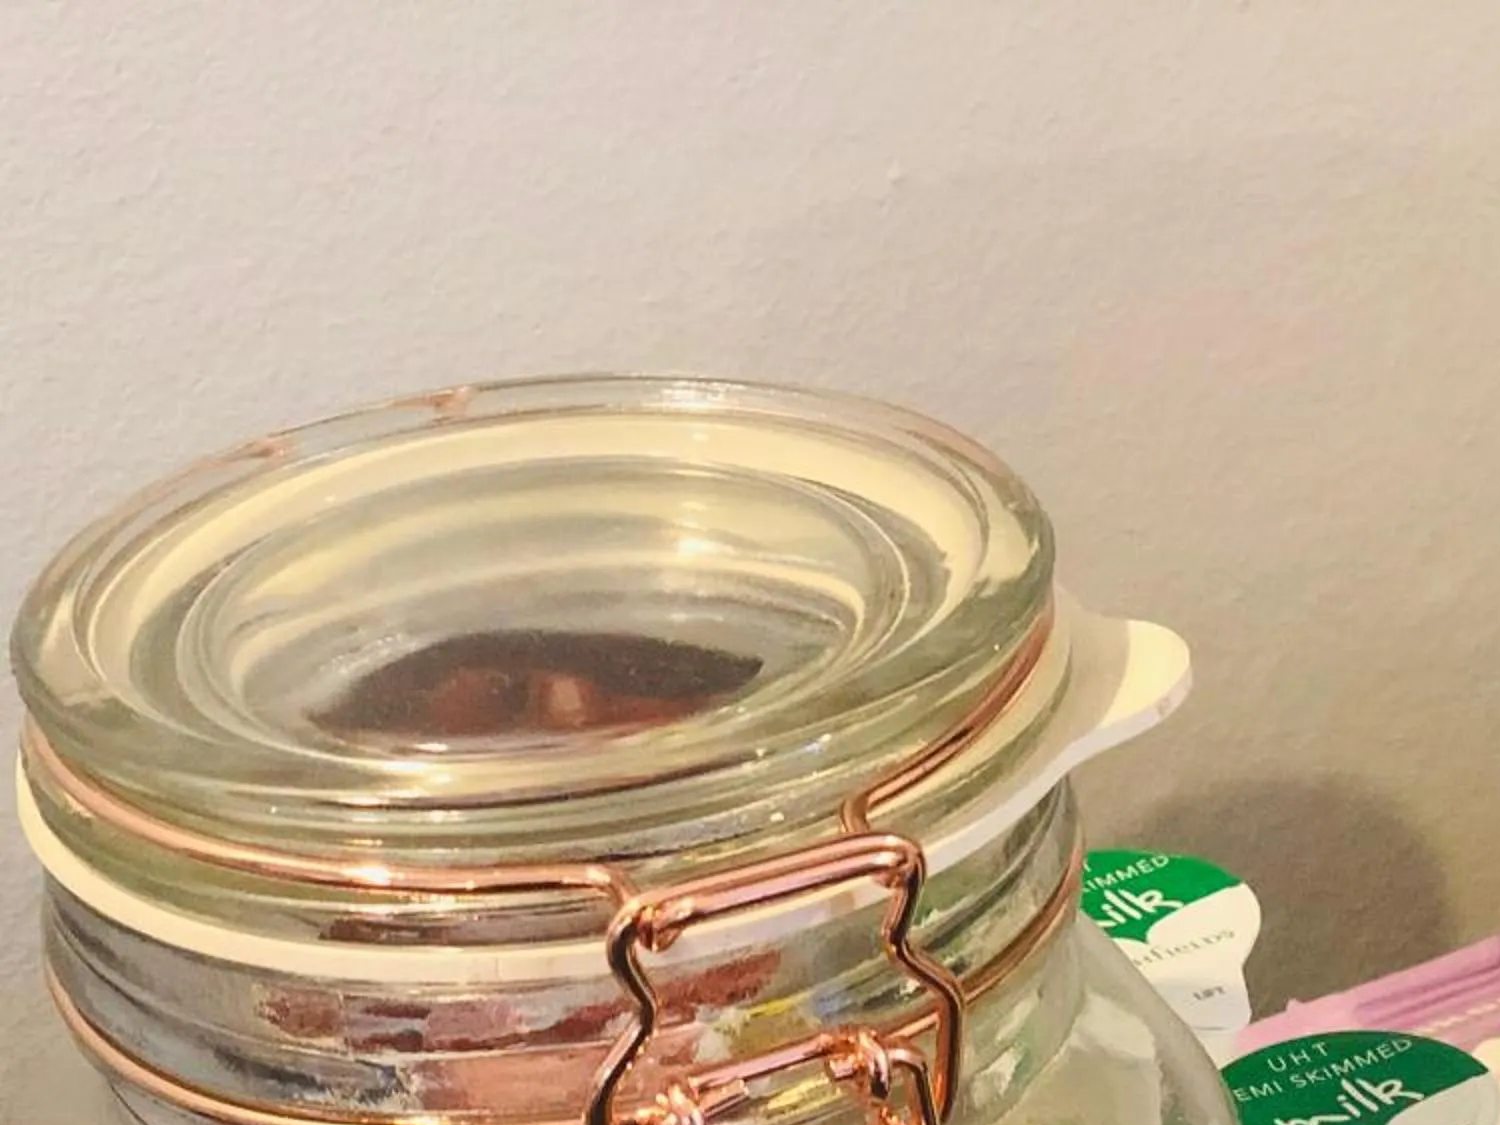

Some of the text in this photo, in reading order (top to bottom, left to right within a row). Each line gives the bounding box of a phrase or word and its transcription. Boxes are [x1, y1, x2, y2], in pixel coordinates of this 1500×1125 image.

[1083, 855, 1169, 893] IMMED
[1233, 1037, 1413, 1102] EMI SKIMMED
[1267, 1042, 1329, 1073] UHT
